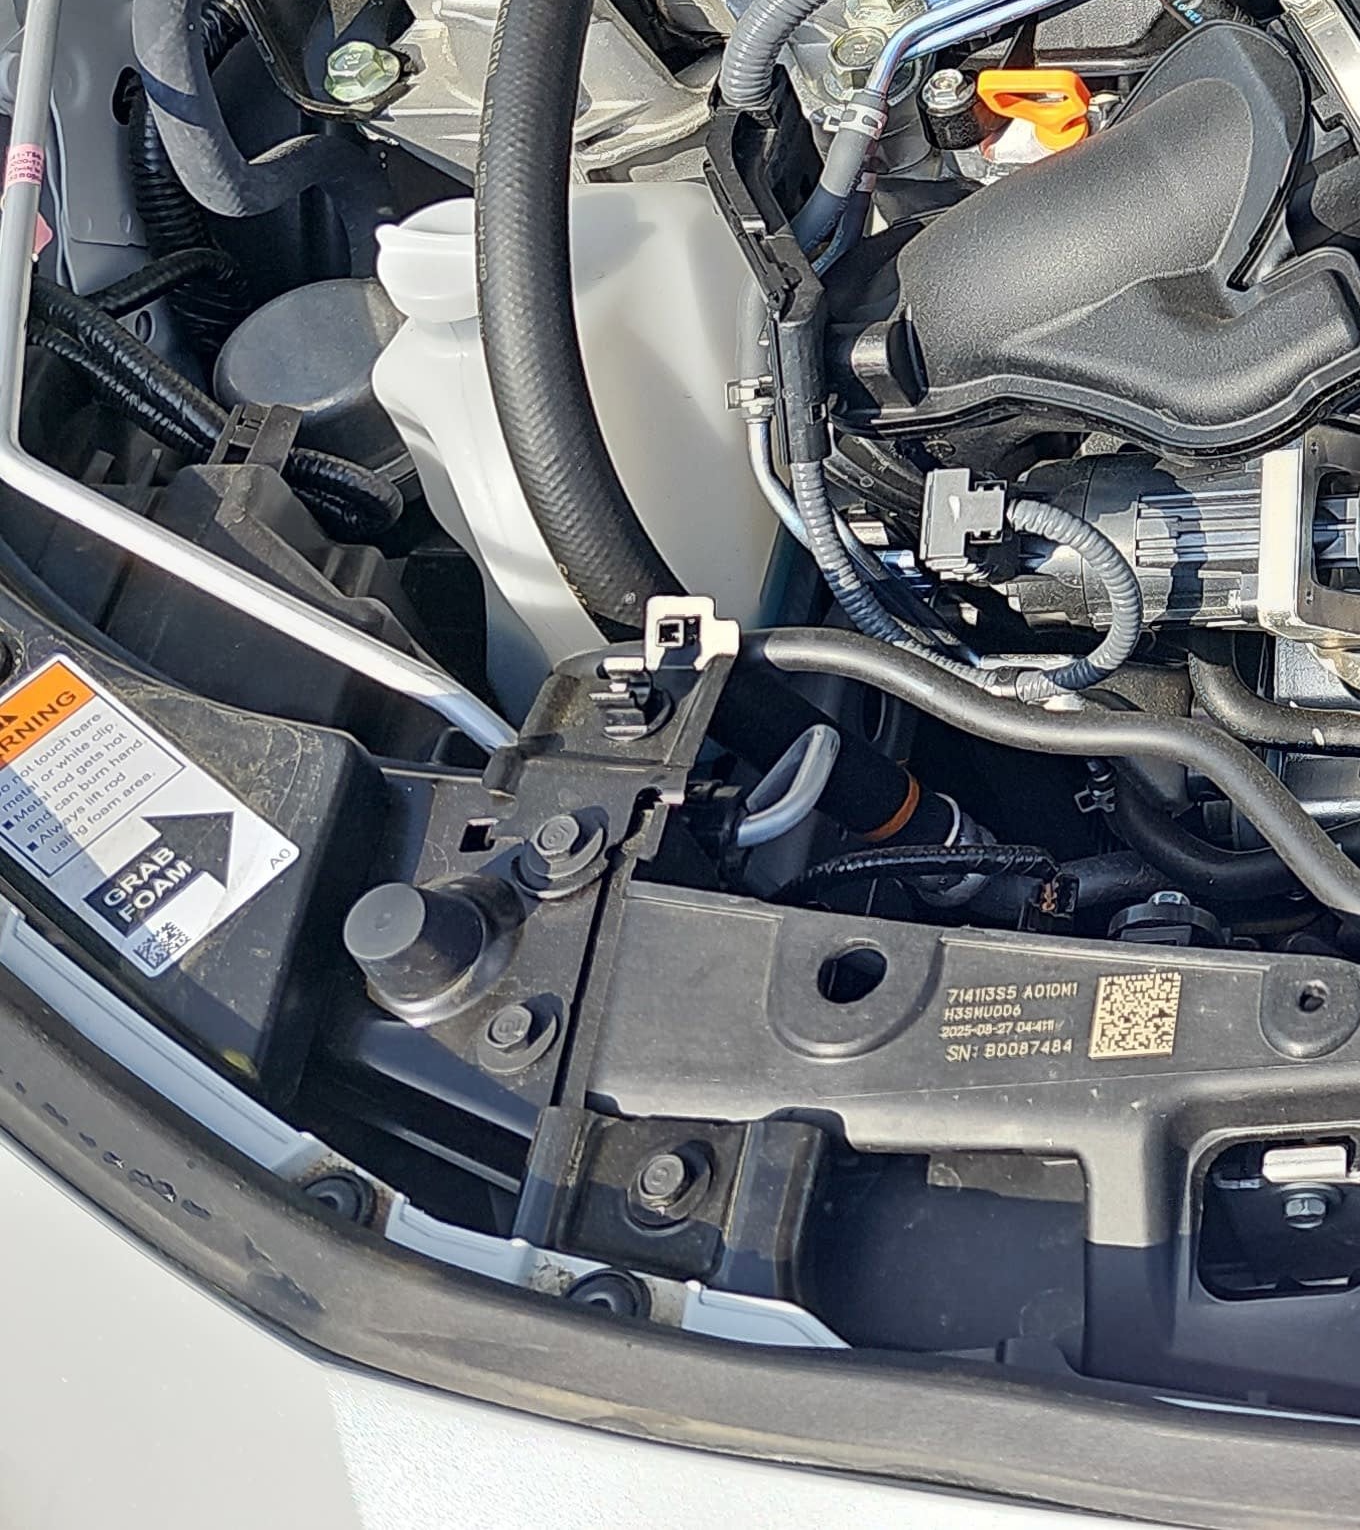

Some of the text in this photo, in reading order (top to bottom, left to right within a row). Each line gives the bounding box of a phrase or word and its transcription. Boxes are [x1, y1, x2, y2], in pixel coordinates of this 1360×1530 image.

[0, 690, 77, 754] RNING
[13, 765, 34, 784] not
[34, 737, 71, 767] touch
[70, 714, 102, 737] bare
[2, 723, 118, 812] metal or white clip.
[14, 732, 128, 822] Metal rod gets hot
[27, 738, 147, 833] and can burn hand.
[38, 772, 127, 845] Always lift rod
[50, 771, 156, 855] using foam area.
[103, 846, 176, 907] GRAB
[118, 859, 193, 923] FOAM
[947, 985, 1017, 1004] 714113S5
[945, 1044, 978, 1062] SN:
